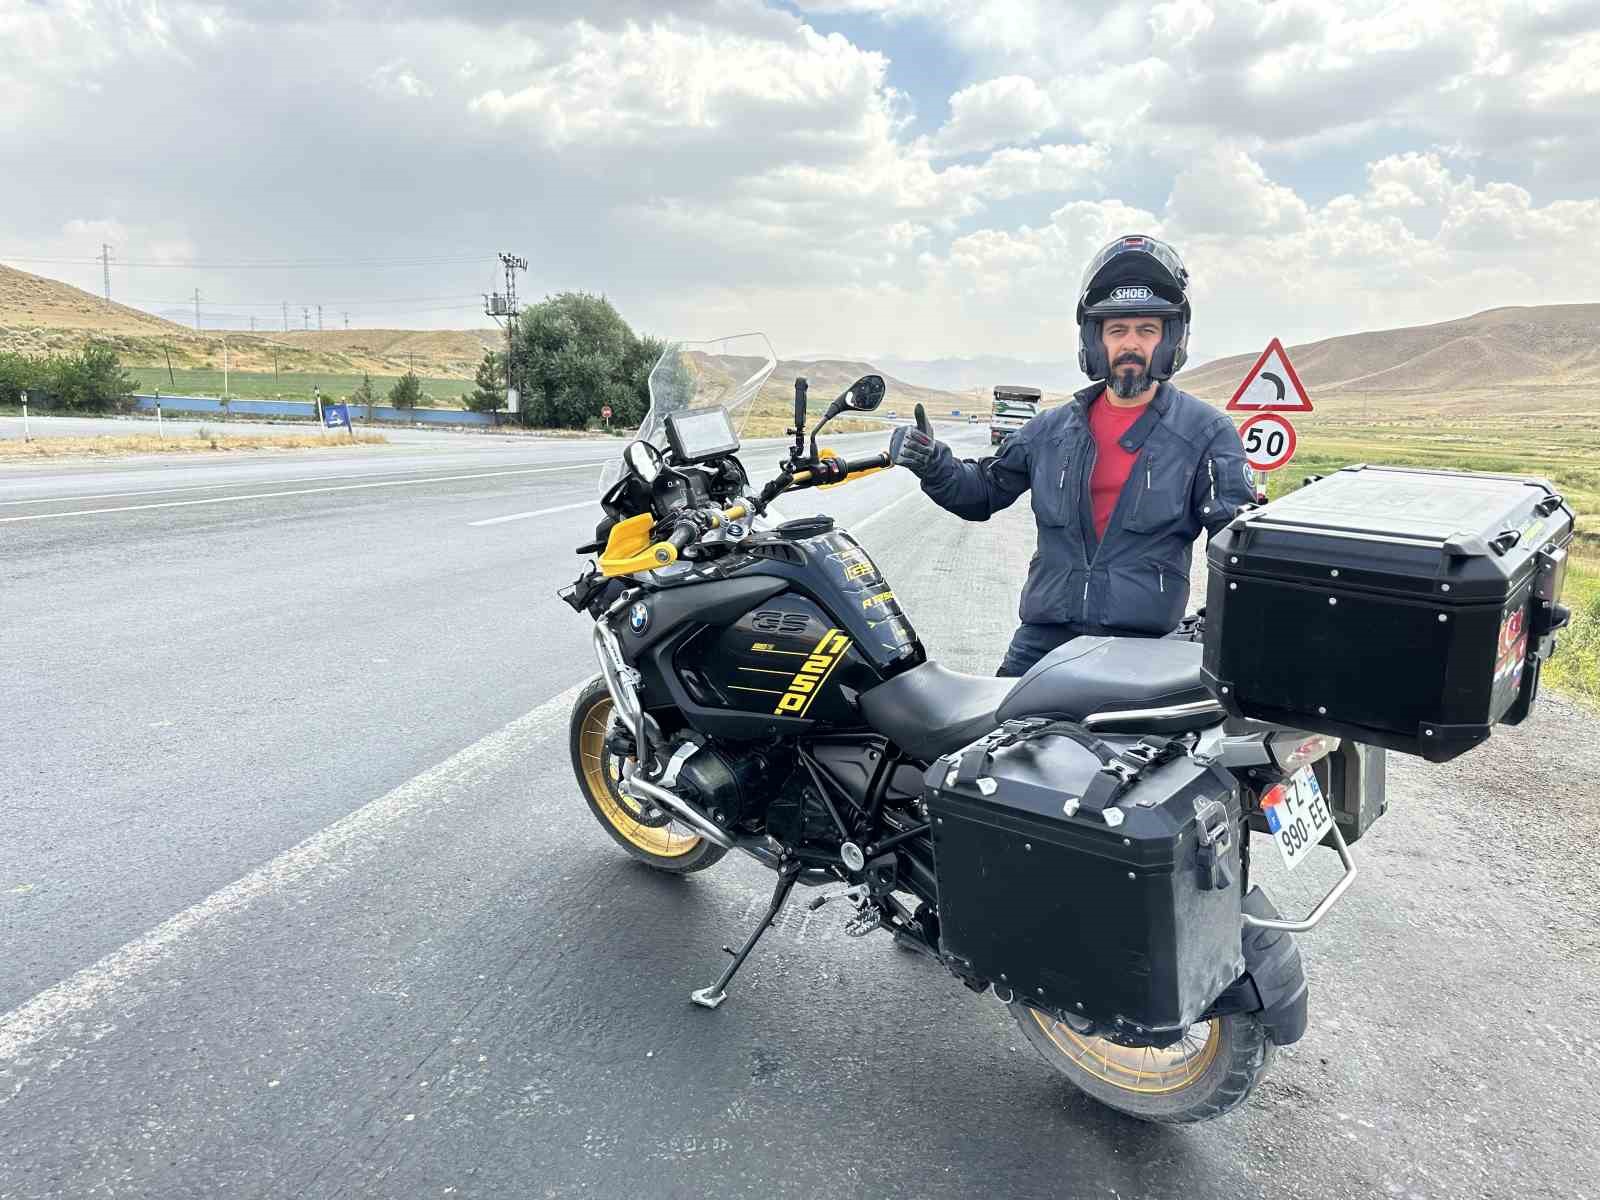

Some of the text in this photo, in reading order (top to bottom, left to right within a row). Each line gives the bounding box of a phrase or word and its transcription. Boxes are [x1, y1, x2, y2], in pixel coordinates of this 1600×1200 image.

[1114, 288, 1148, 300] SHOEI
[1245, 427, 1284, 457] 50
[751, 609, 810, 636] GS
